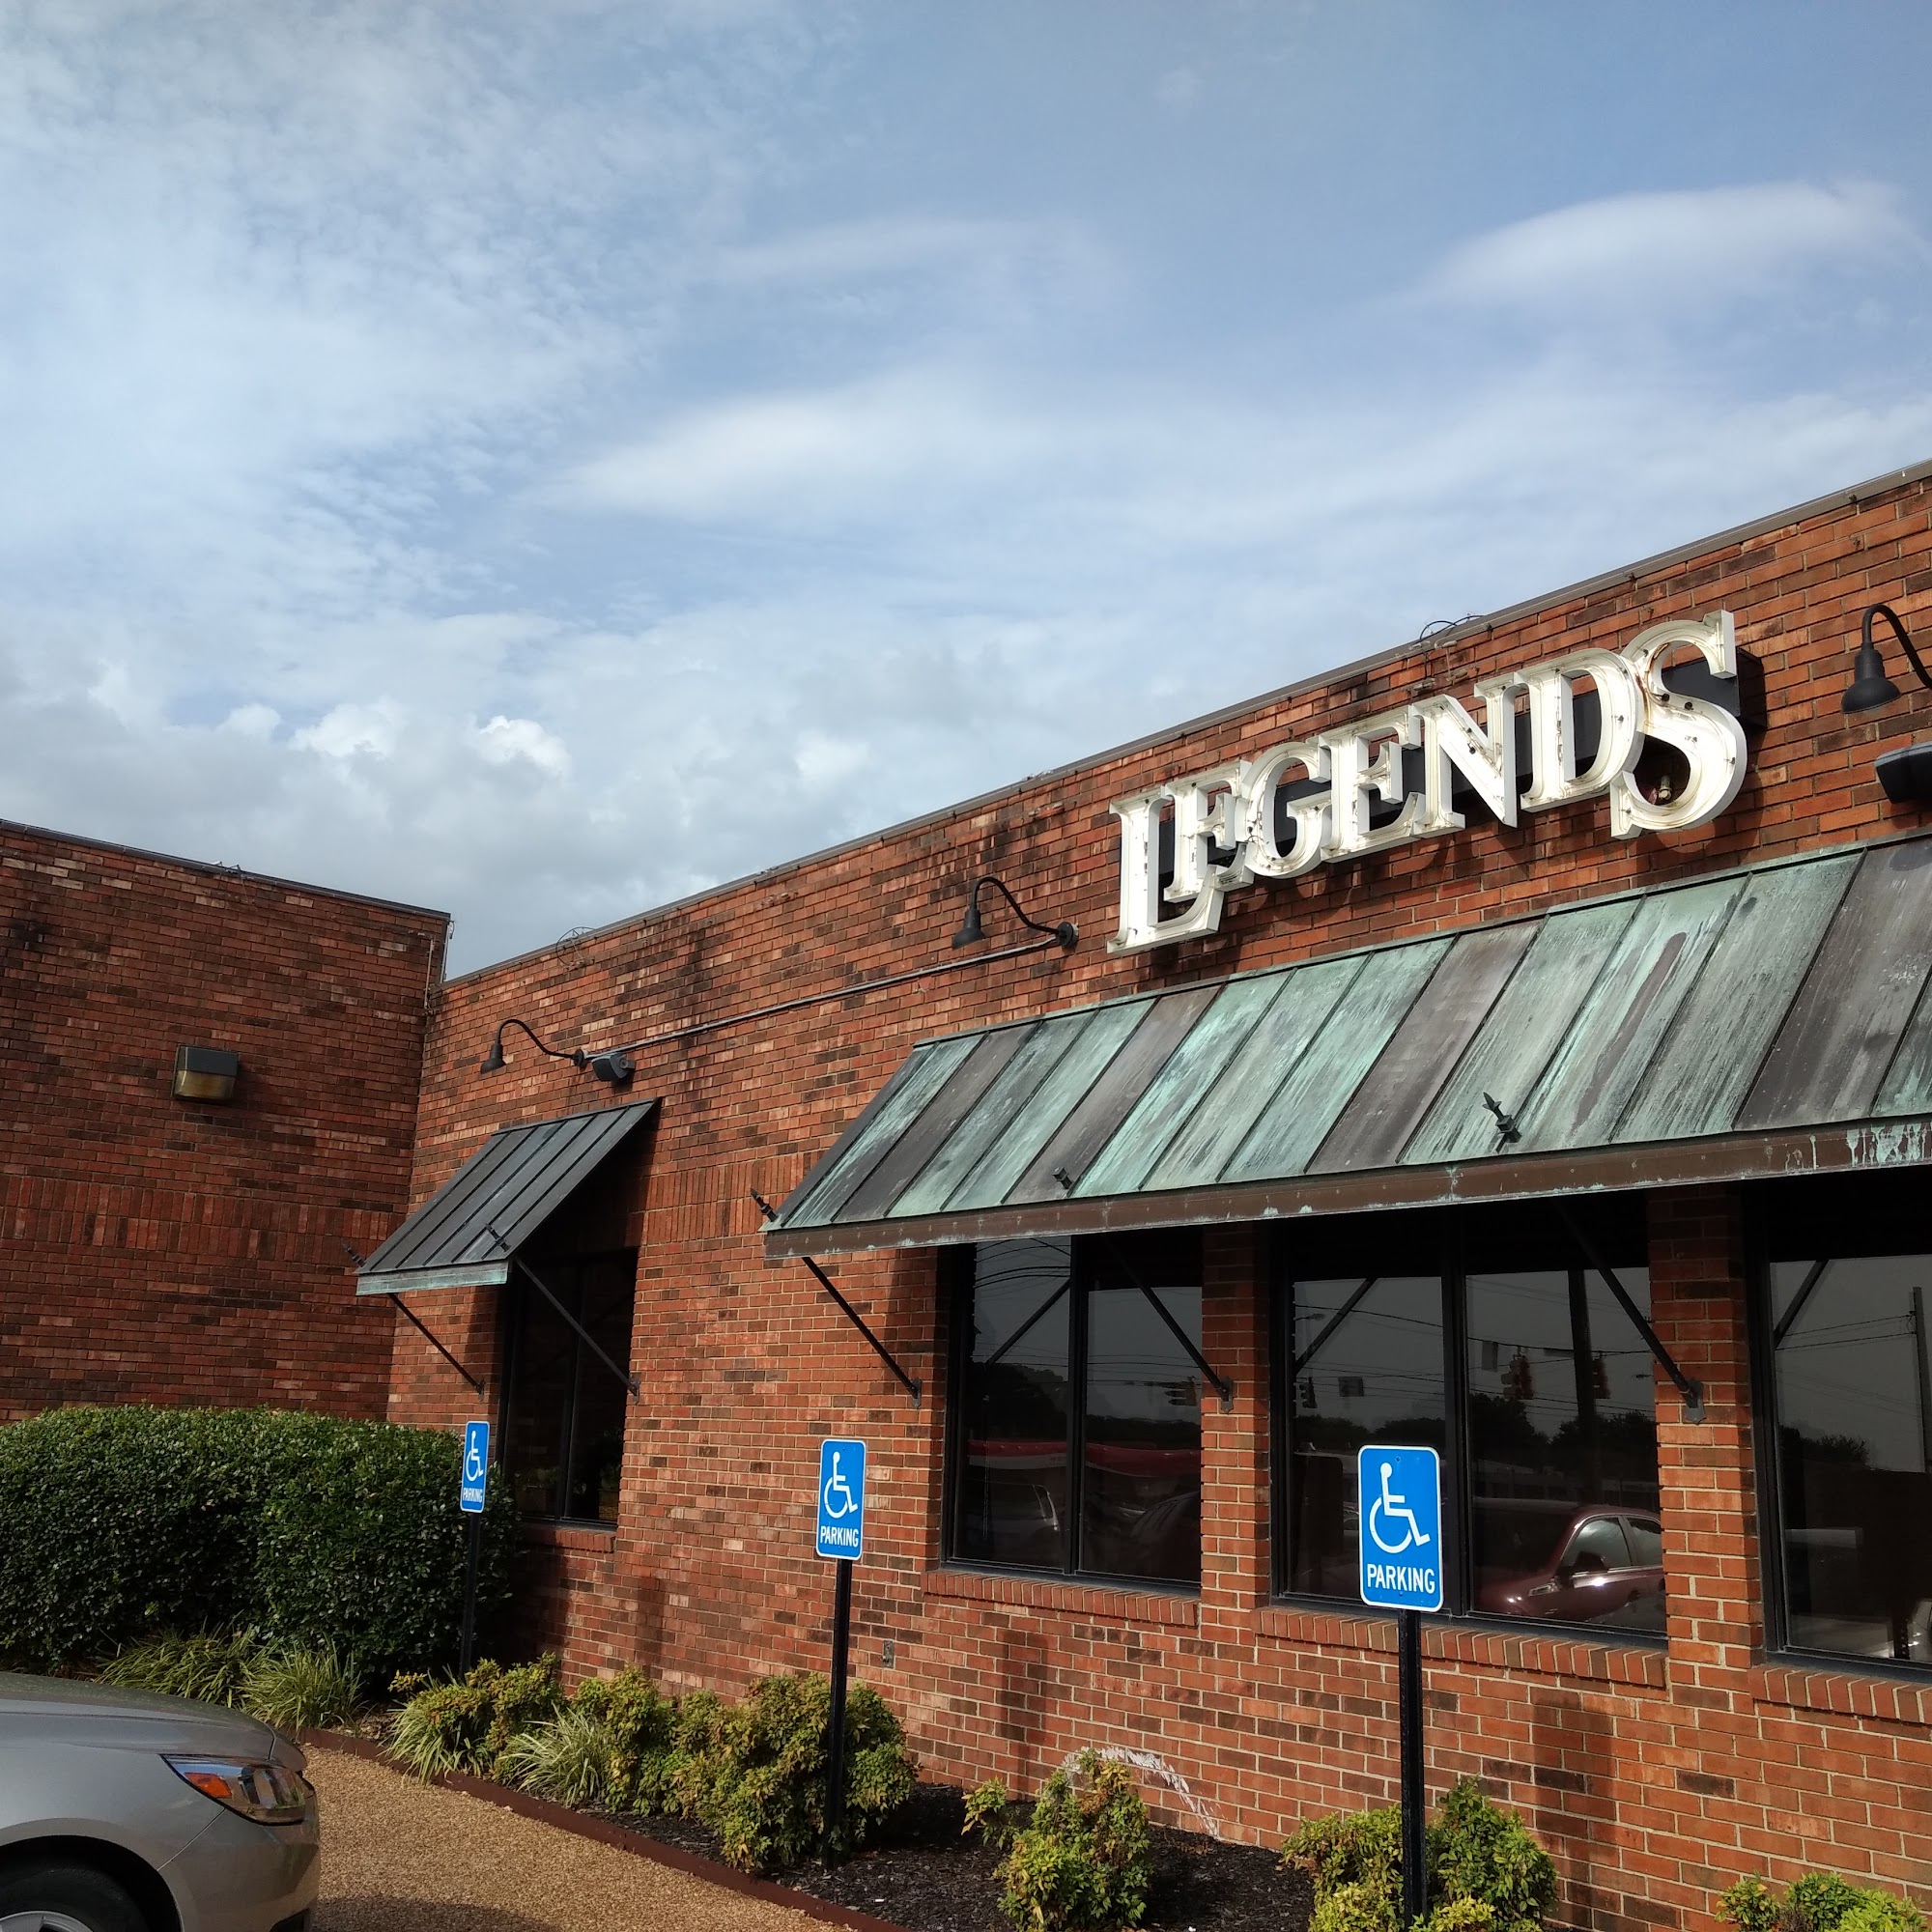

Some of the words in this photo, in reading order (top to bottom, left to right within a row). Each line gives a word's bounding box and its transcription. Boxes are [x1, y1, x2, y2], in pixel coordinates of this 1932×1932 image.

[1107, 610, 1747, 954] LEGENDS
[463, 1488, 483, 1503] PARKING
[820, 1525, 859, 1548] PARKING
[1367, 1563, 1435, 1594] PARKING
